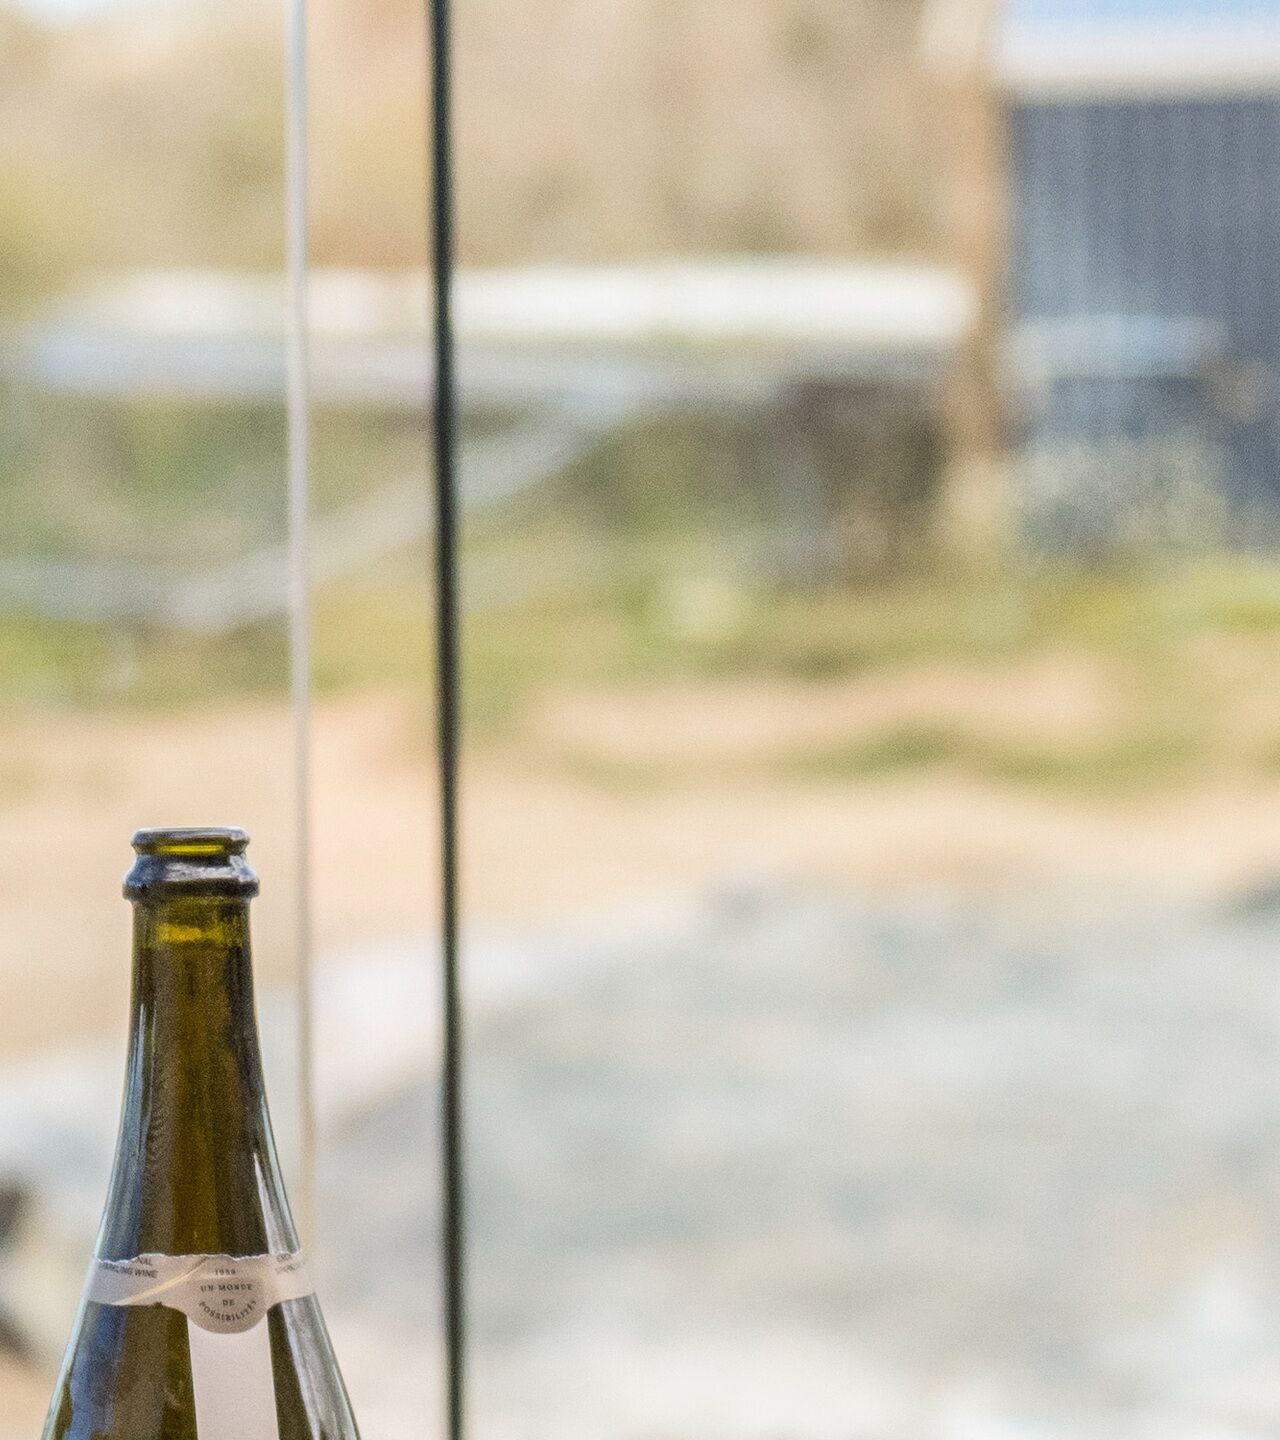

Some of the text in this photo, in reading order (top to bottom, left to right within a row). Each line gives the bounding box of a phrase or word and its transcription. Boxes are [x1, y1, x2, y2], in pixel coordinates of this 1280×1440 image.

[134, 1269, 158, 1279] WINE
[200, 1283, 253, 1293] UN MONDE
[222, 1299, 235, 1307] DE
